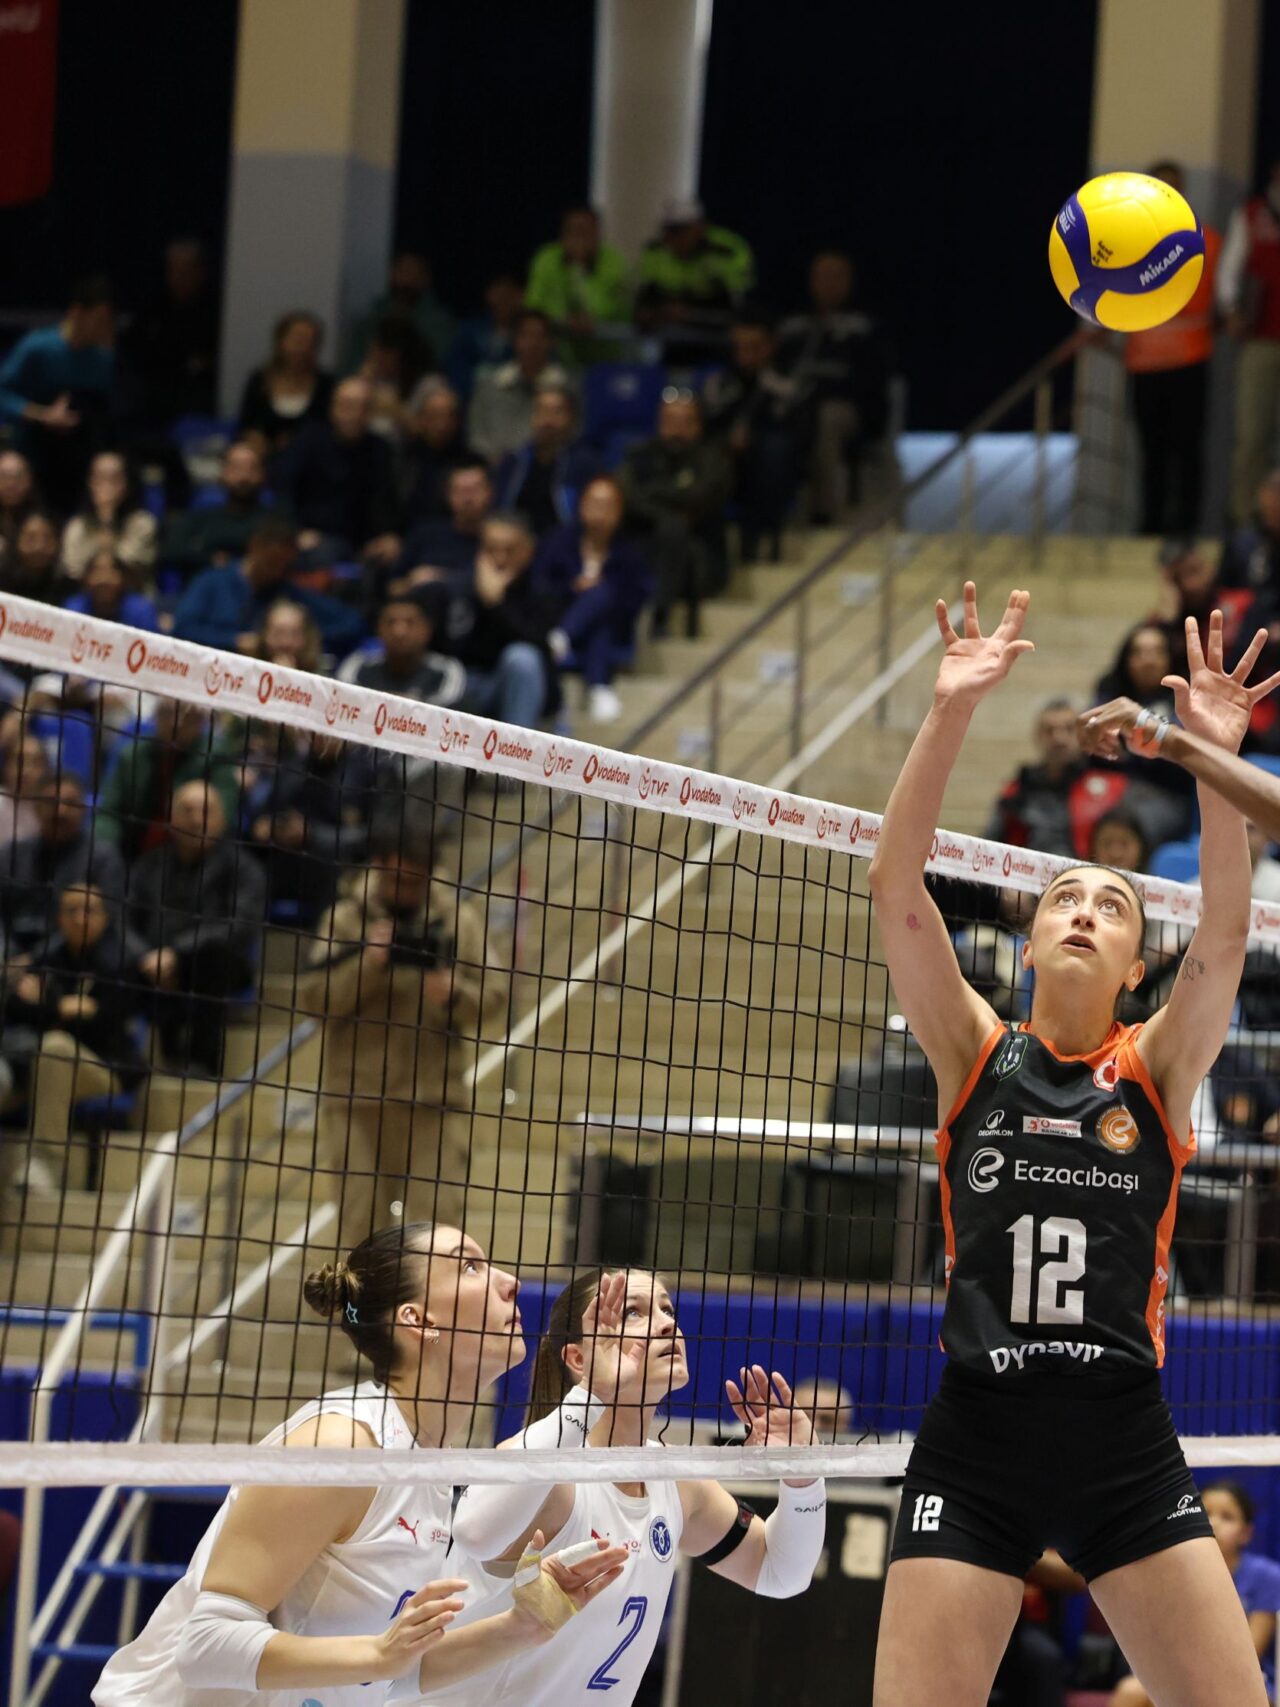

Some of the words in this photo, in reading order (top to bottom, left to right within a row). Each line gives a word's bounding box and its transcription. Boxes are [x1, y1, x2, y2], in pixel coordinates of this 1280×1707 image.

[88, 639, 114, 661] TVF
[224, 672, 245, 694] TVF
[273, 681, 313, 708] vodafone
[339, 703, 361, 724] TVF
[387, 714, 427, 737] vodafone
[452, 731, 470, 751] TVF
[498, 739, 533, 762] vodafone
[556, 756, 574, 775] TVF
[597, 765, 631, 786] vodafone
[651, 779, 670, 799] TVF
[691, 785, 722, 806] vodafone
[742, 799, 757, 818] TVF
[779, 806, 805, 826] vodafone
[827, 819, 842, 836] TVF
[1014, 1159, 1139, 1195] Eczacıbaşı
[1005, 1214, 1087, 1325] 12
[912, 1494, 944, 1532] 12
[587, 1596, 648, 1691] 2
